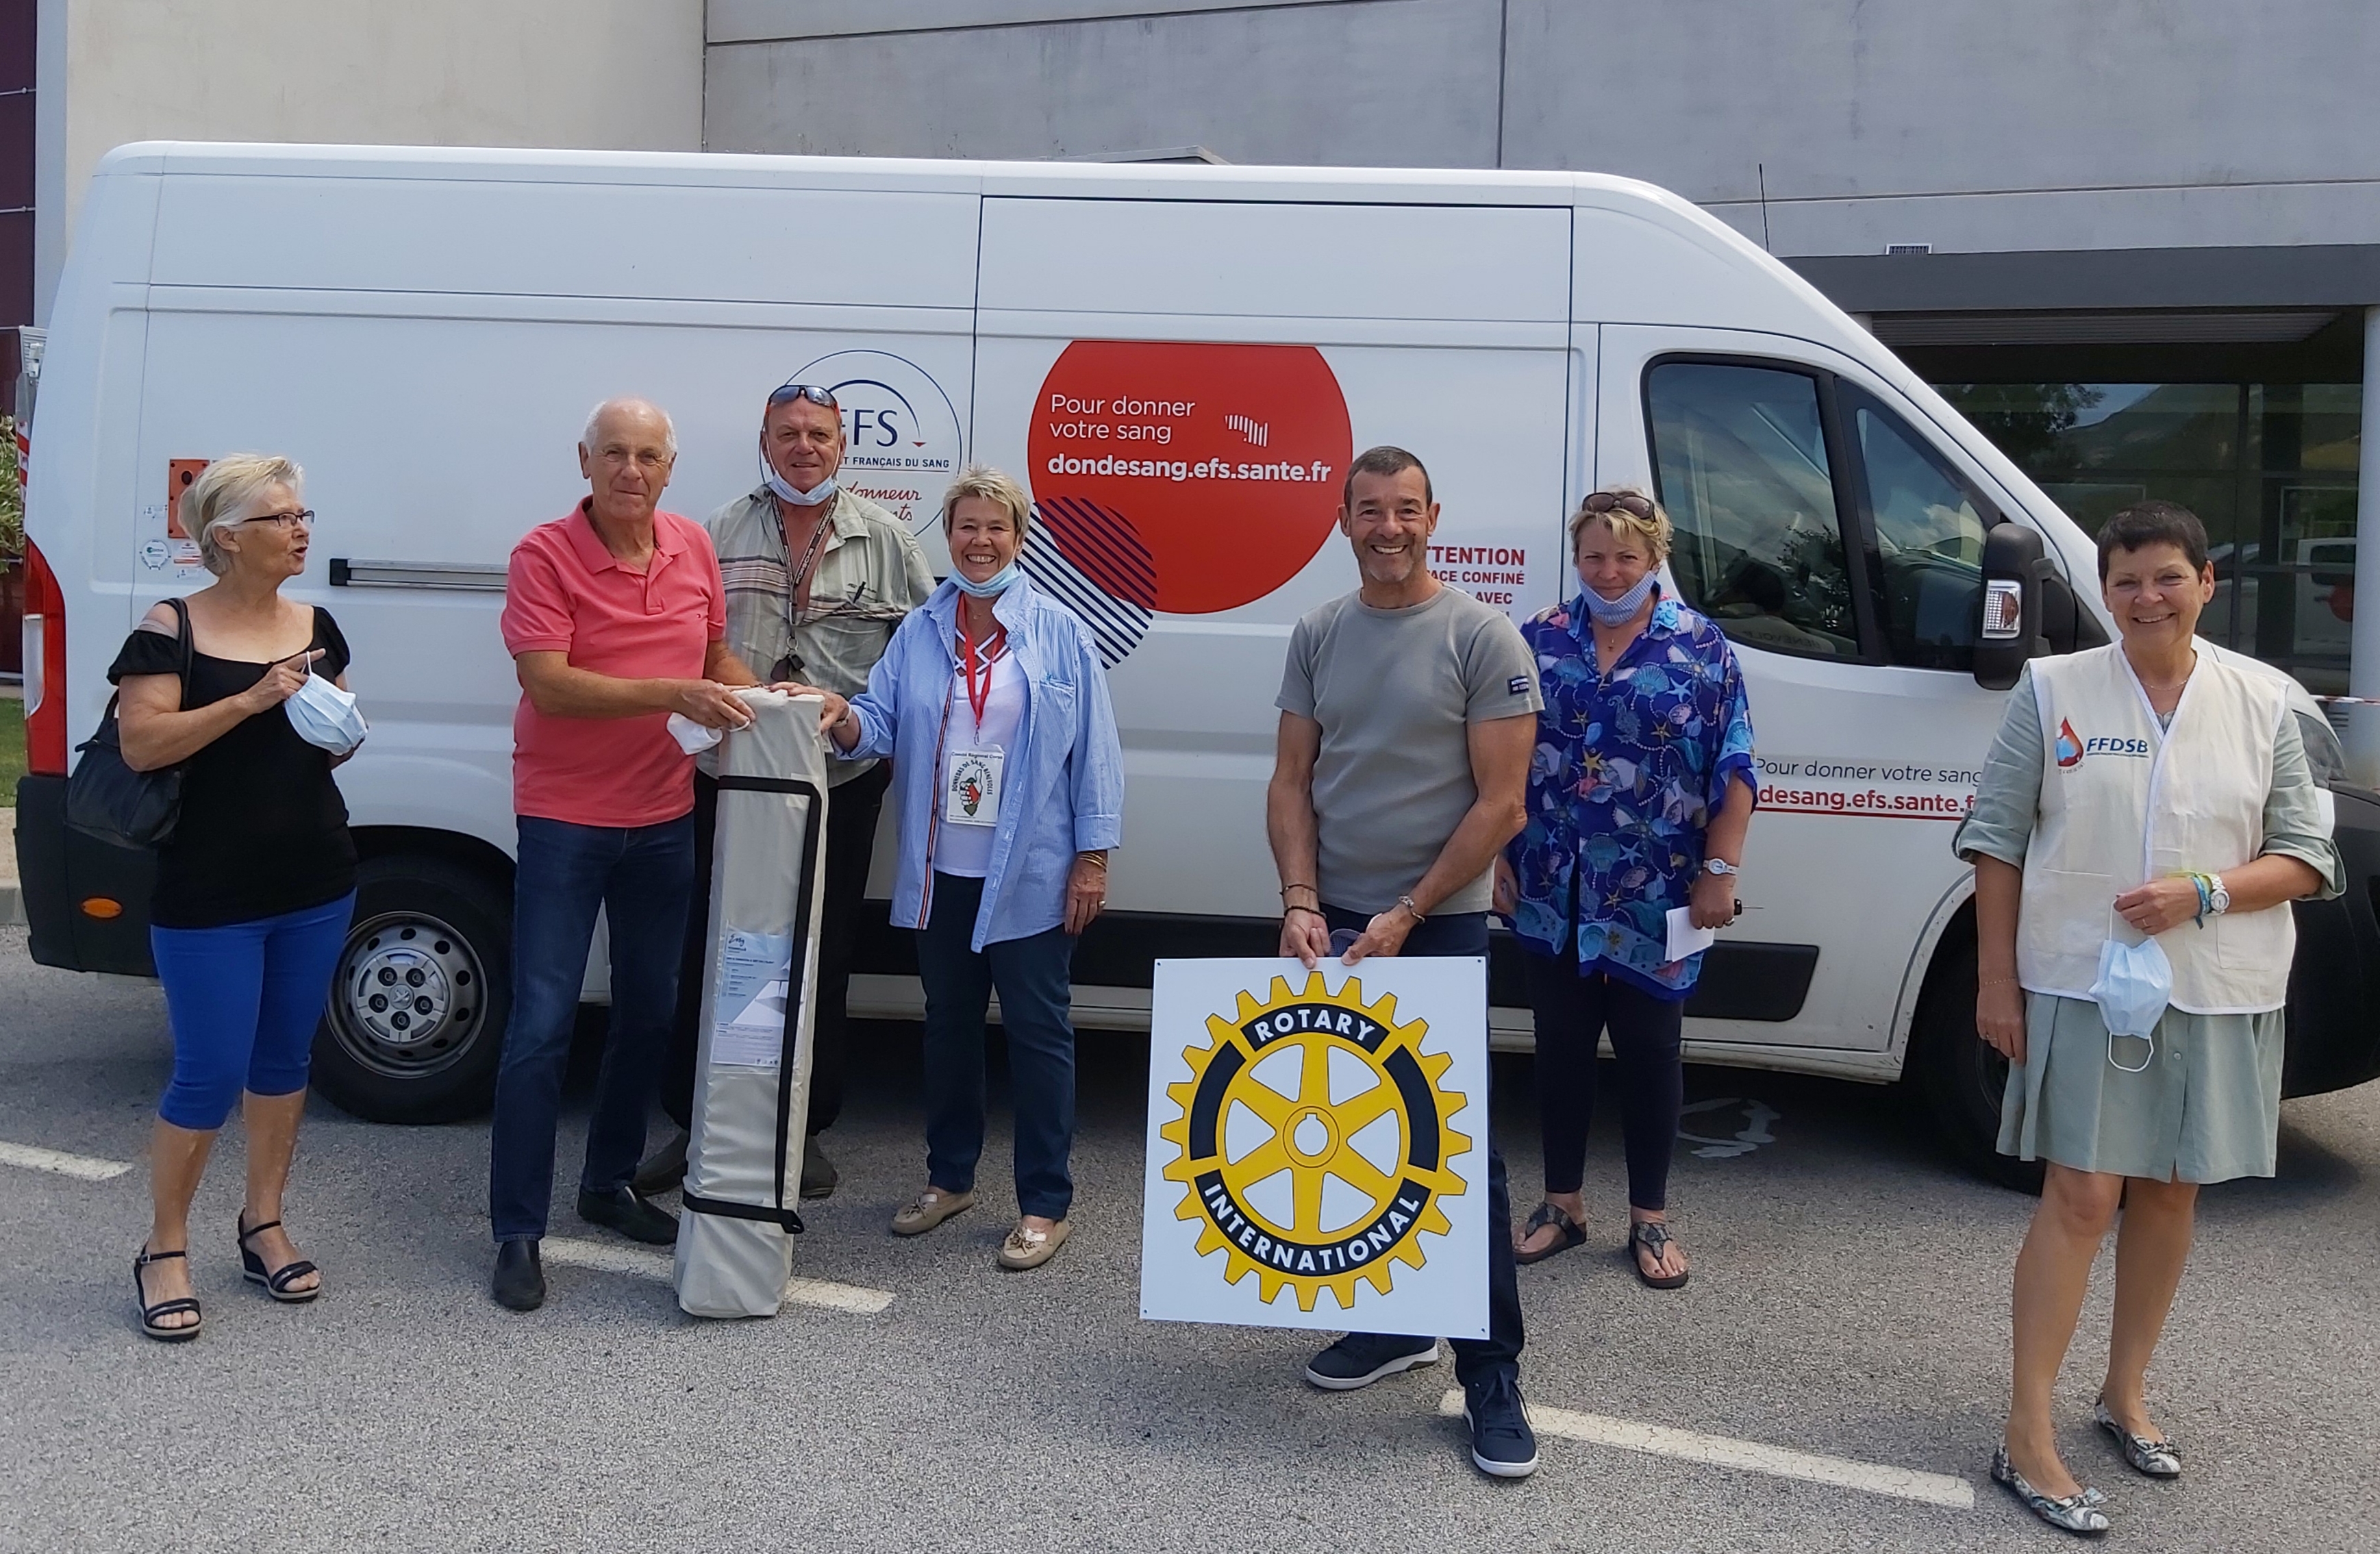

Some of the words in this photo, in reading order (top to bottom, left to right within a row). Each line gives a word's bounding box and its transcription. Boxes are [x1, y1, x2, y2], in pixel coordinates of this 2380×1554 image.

[1051, 394, 1106, 414] Pour
[1112, 395, 1196, 416] donner
[1049, 420, 1110, 439] votre
[1116, 425, 1172, 444] sang
[853, 456, 901, 468] FRANÇAIS
[905, 458, 919, 467] DU
[922, 459, 950, 468] SANG
[1047, 453, 1331, 482] dondesang.efs.sante.fr
[817, 501, 836, 535] PORSCHE
[795, 547, 815, 585] PORSCHE
[1427, 546, 1525, 566] TENTION
[1427, 570, 1457, 582] ACE
[1462, 570, 1525, 585] CONFINÉ
[1475, 591, 1513, 605] AVEC
[2086, 738, 2149, 753] FFDSB
[1756, 757, 1799, 775] Pour
[1804, 760, 1877, 780] donner
[1881, 765, 1933, 781] votre
[1758, 784, 1975, 813] desang.efs.sante.f
[1254, 1008, 1375, 1042] ROTARY
[1204, 1183, 1420, 1271] INTERNATIONAL
